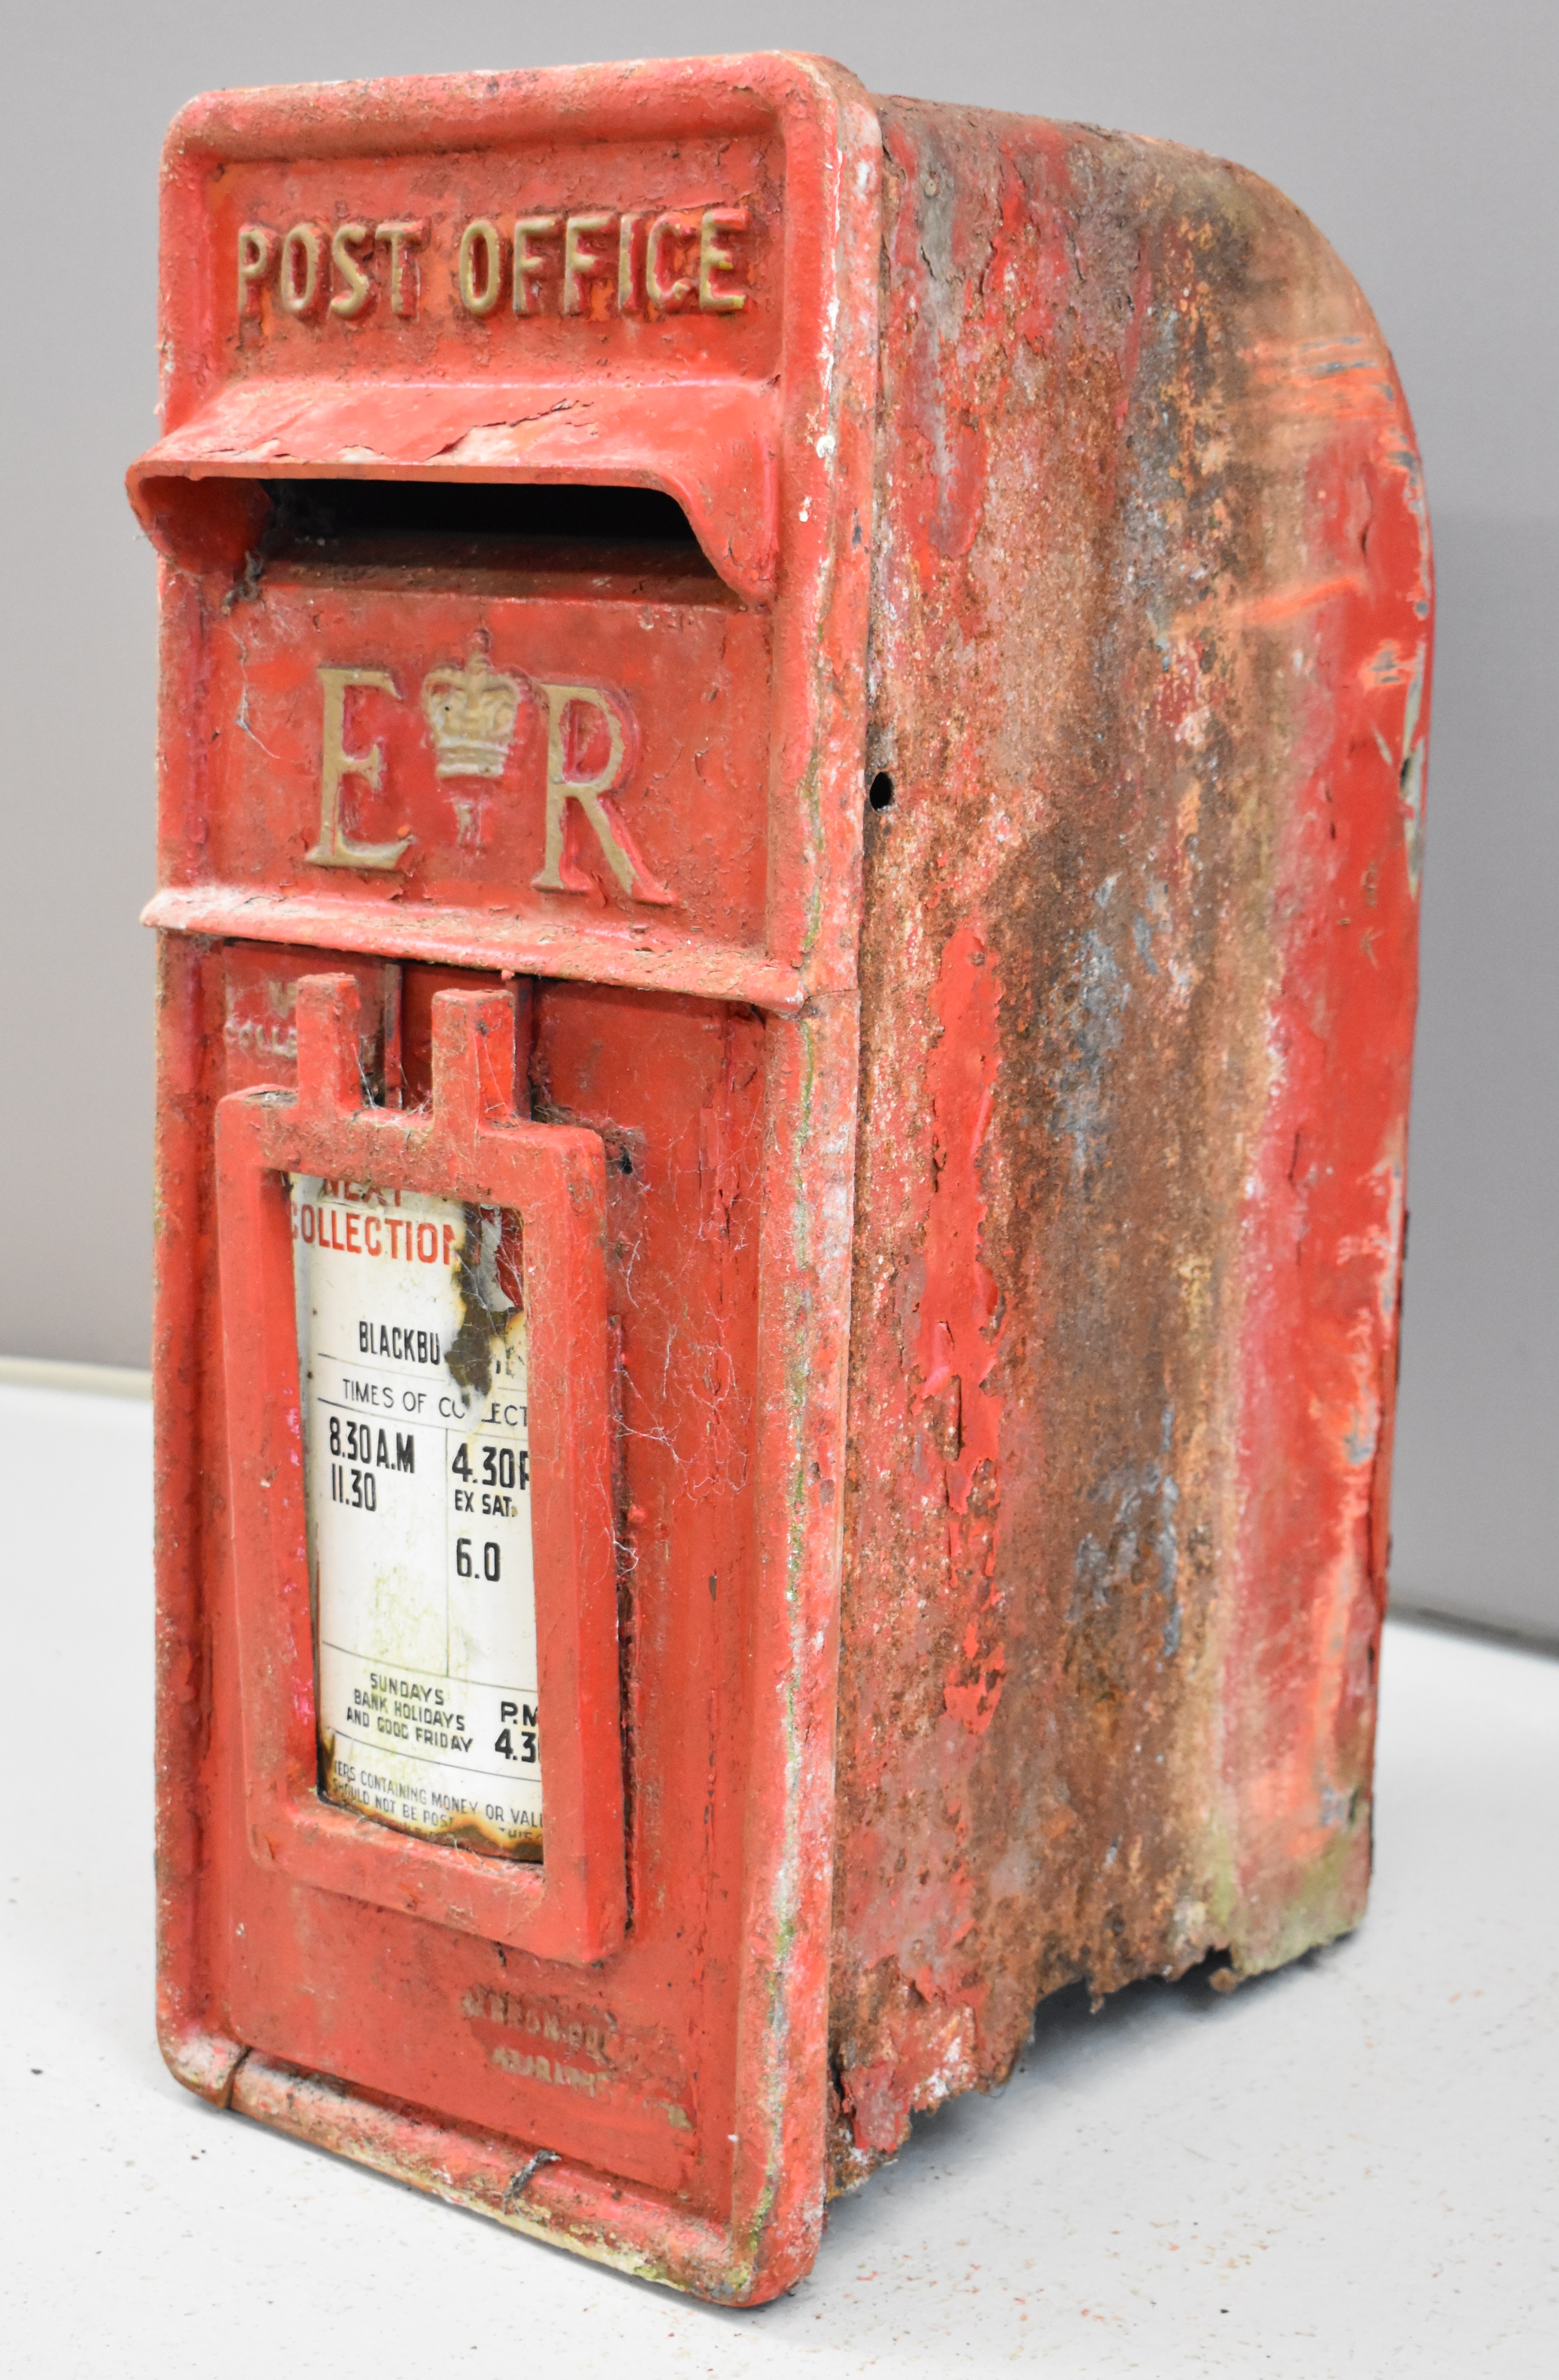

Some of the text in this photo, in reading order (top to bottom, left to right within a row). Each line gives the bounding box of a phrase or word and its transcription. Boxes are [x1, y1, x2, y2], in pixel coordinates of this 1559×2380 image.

[237, 208, 750, 321] POST OFFICE
[305, 667, 416, 870] E
[532, 680, 674, 905] R
[342, 1378, 394, 1408] TIMES
[402, 1391, 427, 1413] OF
[332, 1463, 377, 1512] 11.30
[454, 1489, 474, 1513] EX
[456, 1538, 501, 1582] 6.0
[354, 1688, 465, 1731] BANK HOLIDAYS
[370, 1673, 444, 1706] SUNDAYS
[346, 1706, 370, 1728] AND
[416, 1726, 473, 1753] FRIDAY
[360, 1770, 427, 1805] CONTAINING
[431, 1792, 478, 1814] MONEY
[485, 1804, 504, 1822] OR
[375, 1795, 396, 1813] NOT
[403, 1804, 417, 1821] BE
